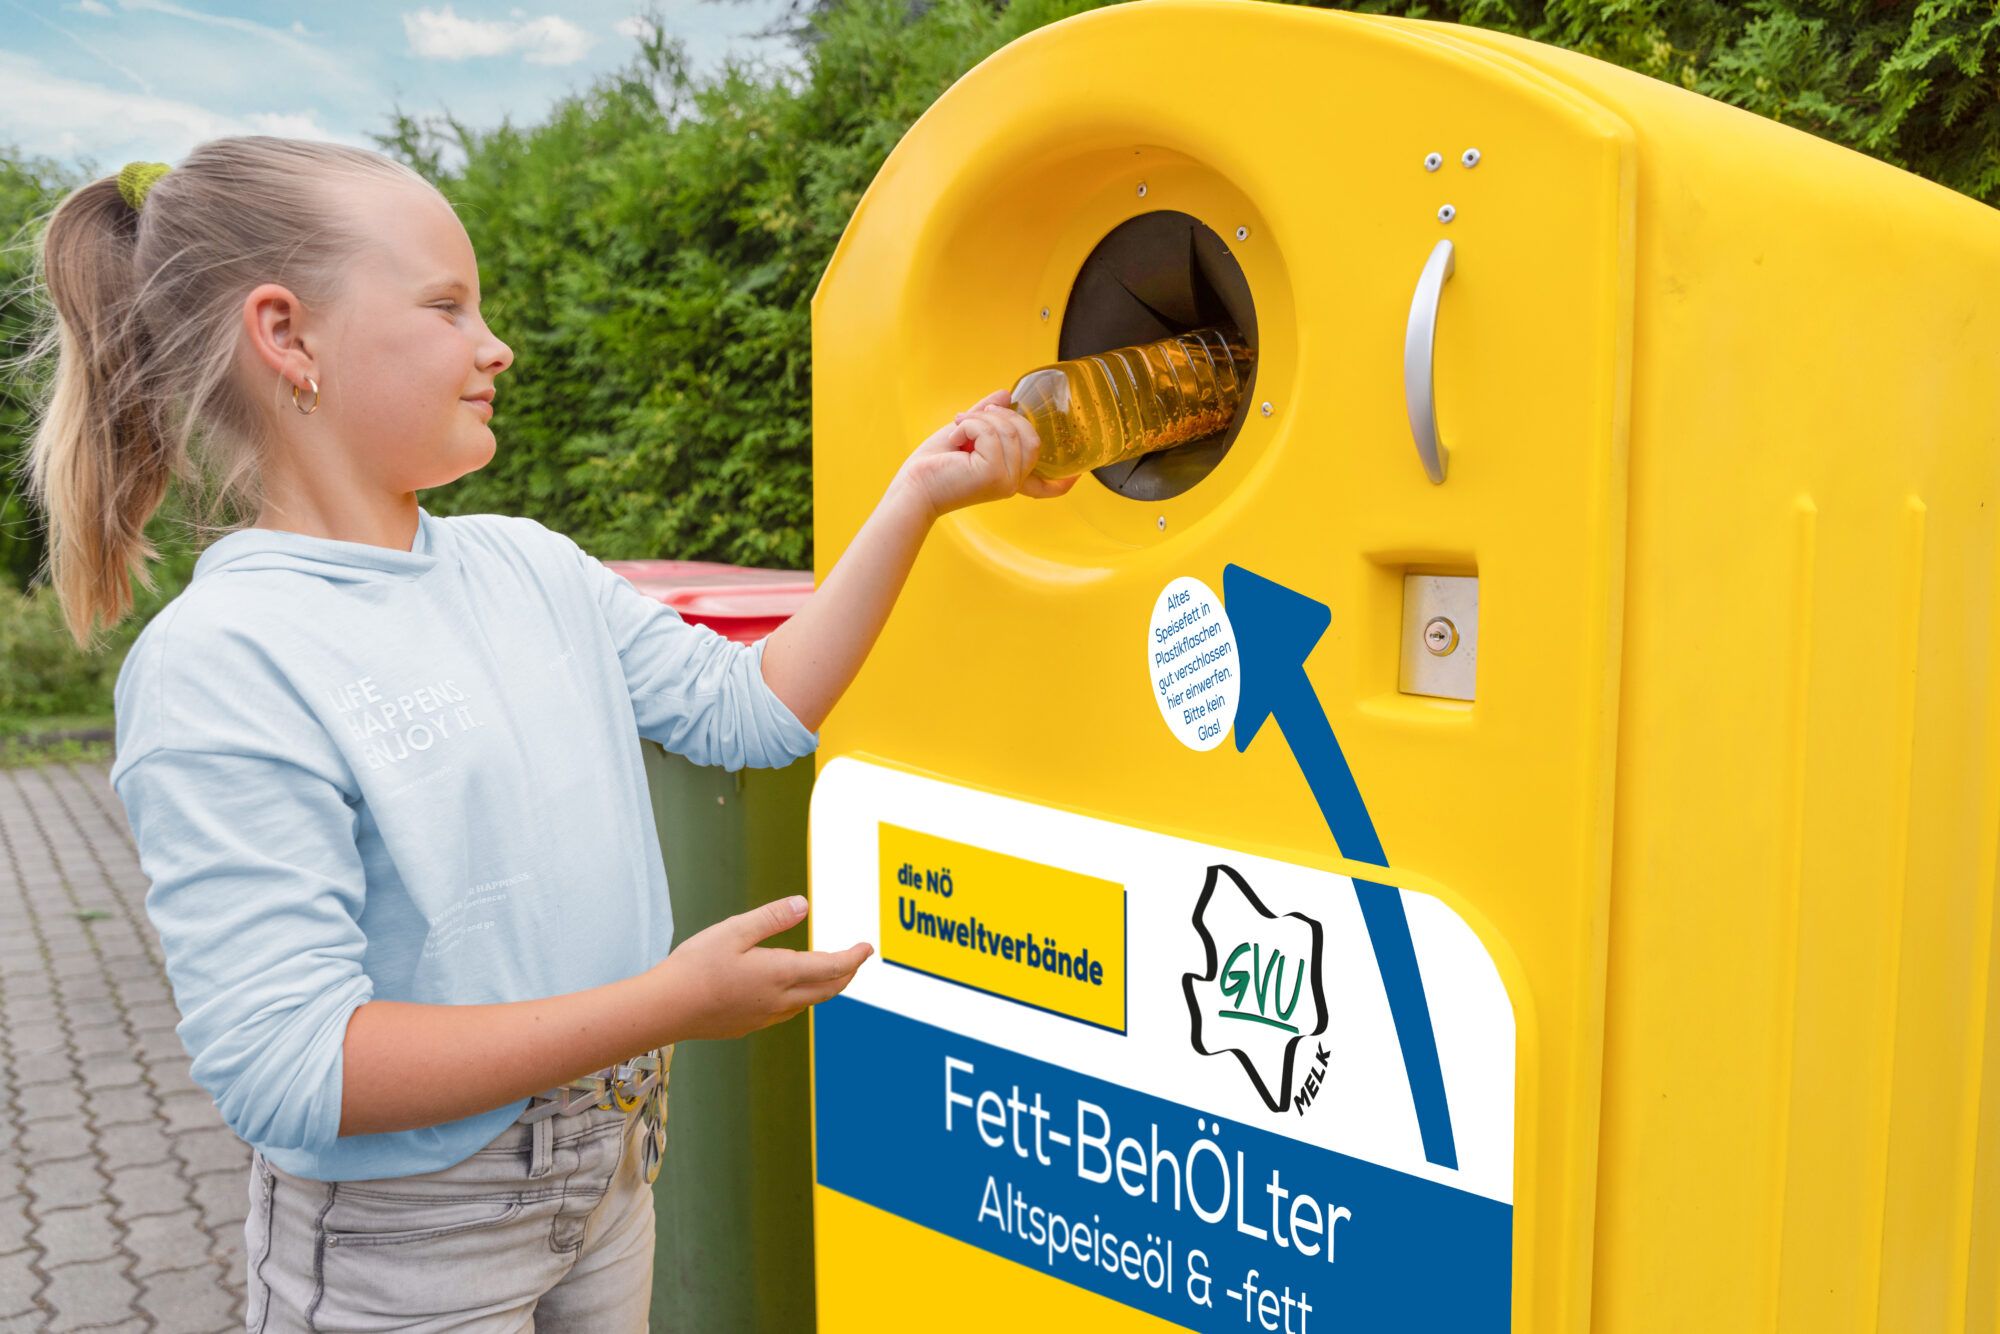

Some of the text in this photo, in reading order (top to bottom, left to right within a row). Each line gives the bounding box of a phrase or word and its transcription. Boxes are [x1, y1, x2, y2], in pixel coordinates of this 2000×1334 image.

[1155, 602, 1211, 644] Speisefett in
[1167, 589, 1191, 612] Altes
[1155, 621, 1221, 668] Plastikflaschen
[1158, 641, 1232, 696] gut verschlossen
[327, 676, 383, 712] LIFE
[344, 679, 471, 742] HAPPENS.
[1166, 666, 1233, 710] hier einwerfen.
[1183, 694, 1226, 725] Bitte kein
[364, 705, 485, 770] ENJOY IT.
[1198, 718, 1221, 741] Glas!
[898, 863, 953, 898] die NÖ
[898, 897, 1104, 987] Umweltverbände
[1219, 942, 1305, 1021] GVU
[1293, 1041, 1331, 1116] MELK
[944, 1055, 1352, 1263] Fett-BehÖLter
[978, 1175, 1313, 1334] Altspeiseöl & -fett
